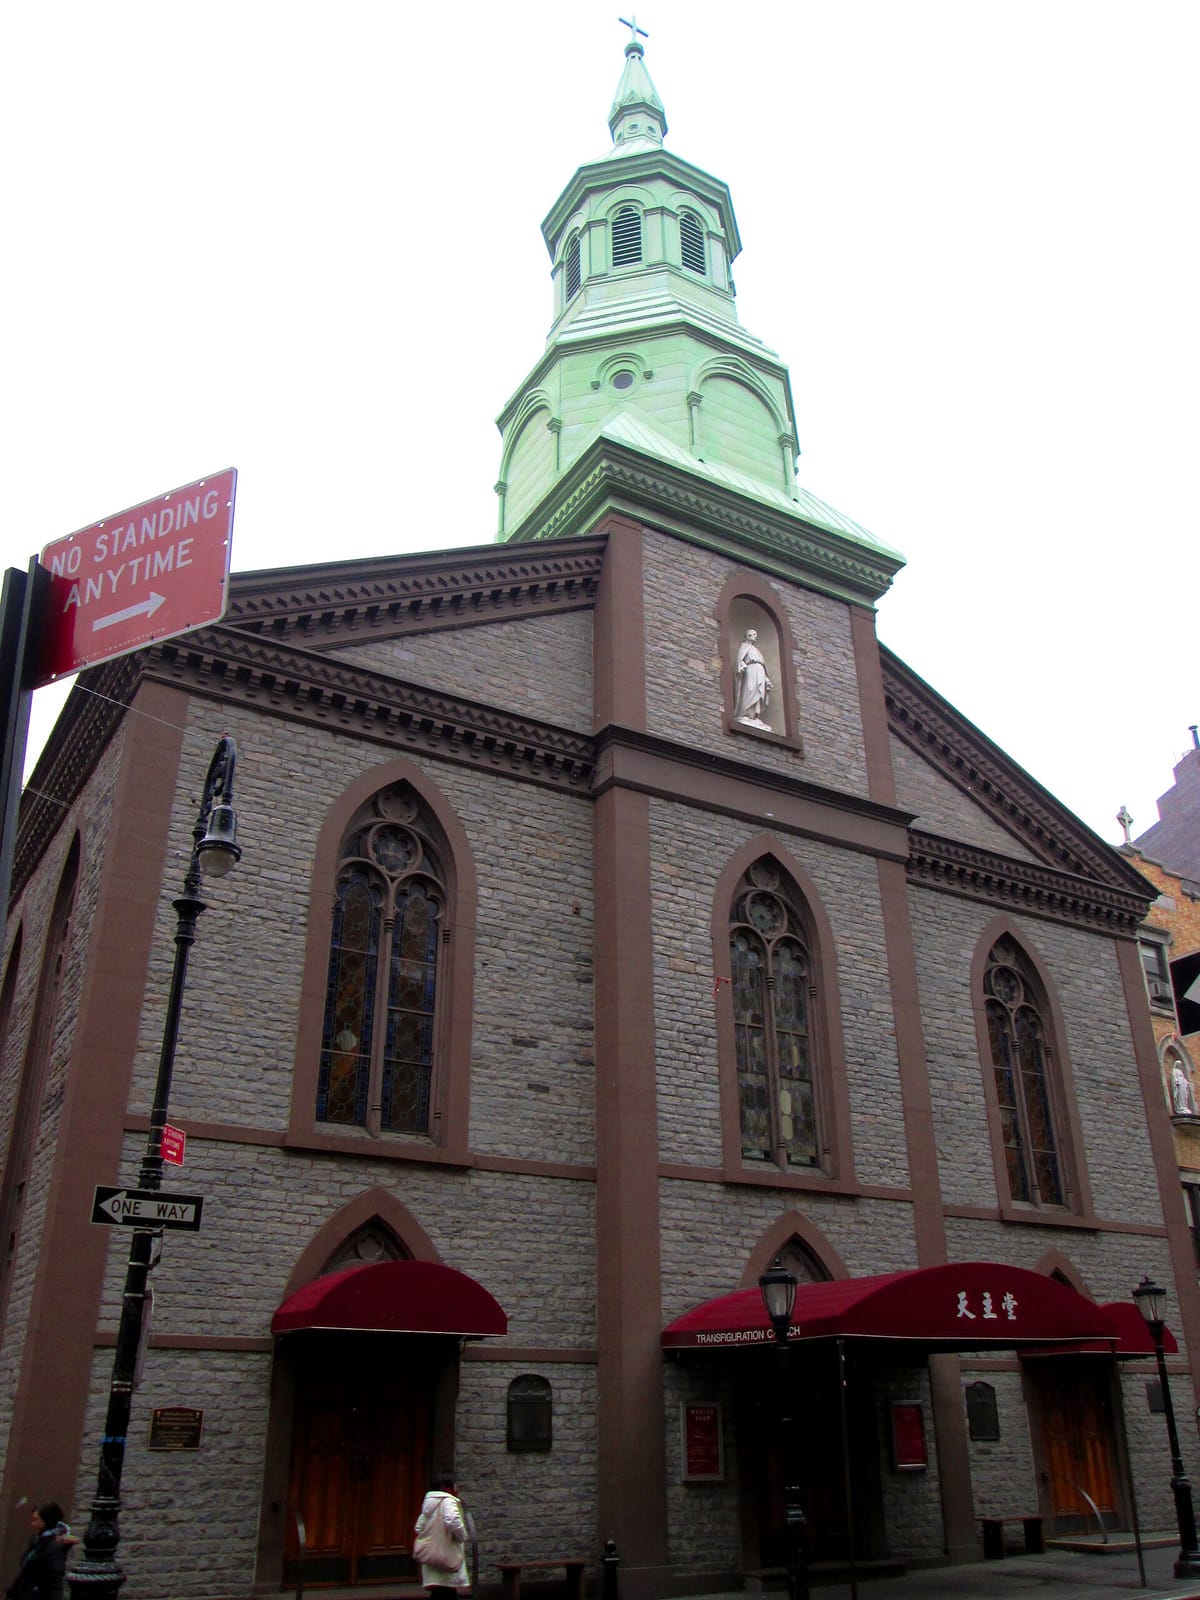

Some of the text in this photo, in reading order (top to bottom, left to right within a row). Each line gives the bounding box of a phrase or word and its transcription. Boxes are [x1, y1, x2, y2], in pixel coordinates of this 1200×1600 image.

[50, 490, 219, 582] NO STANDING
[63, 538, 194, 613] ANYTIME
[111, 1200, 189, 1219] ONE WAY
[956, 1291, 1018, 1320] 天主堂
[696, 1326, 801, 1344] TRANSFIGURATION CCH
